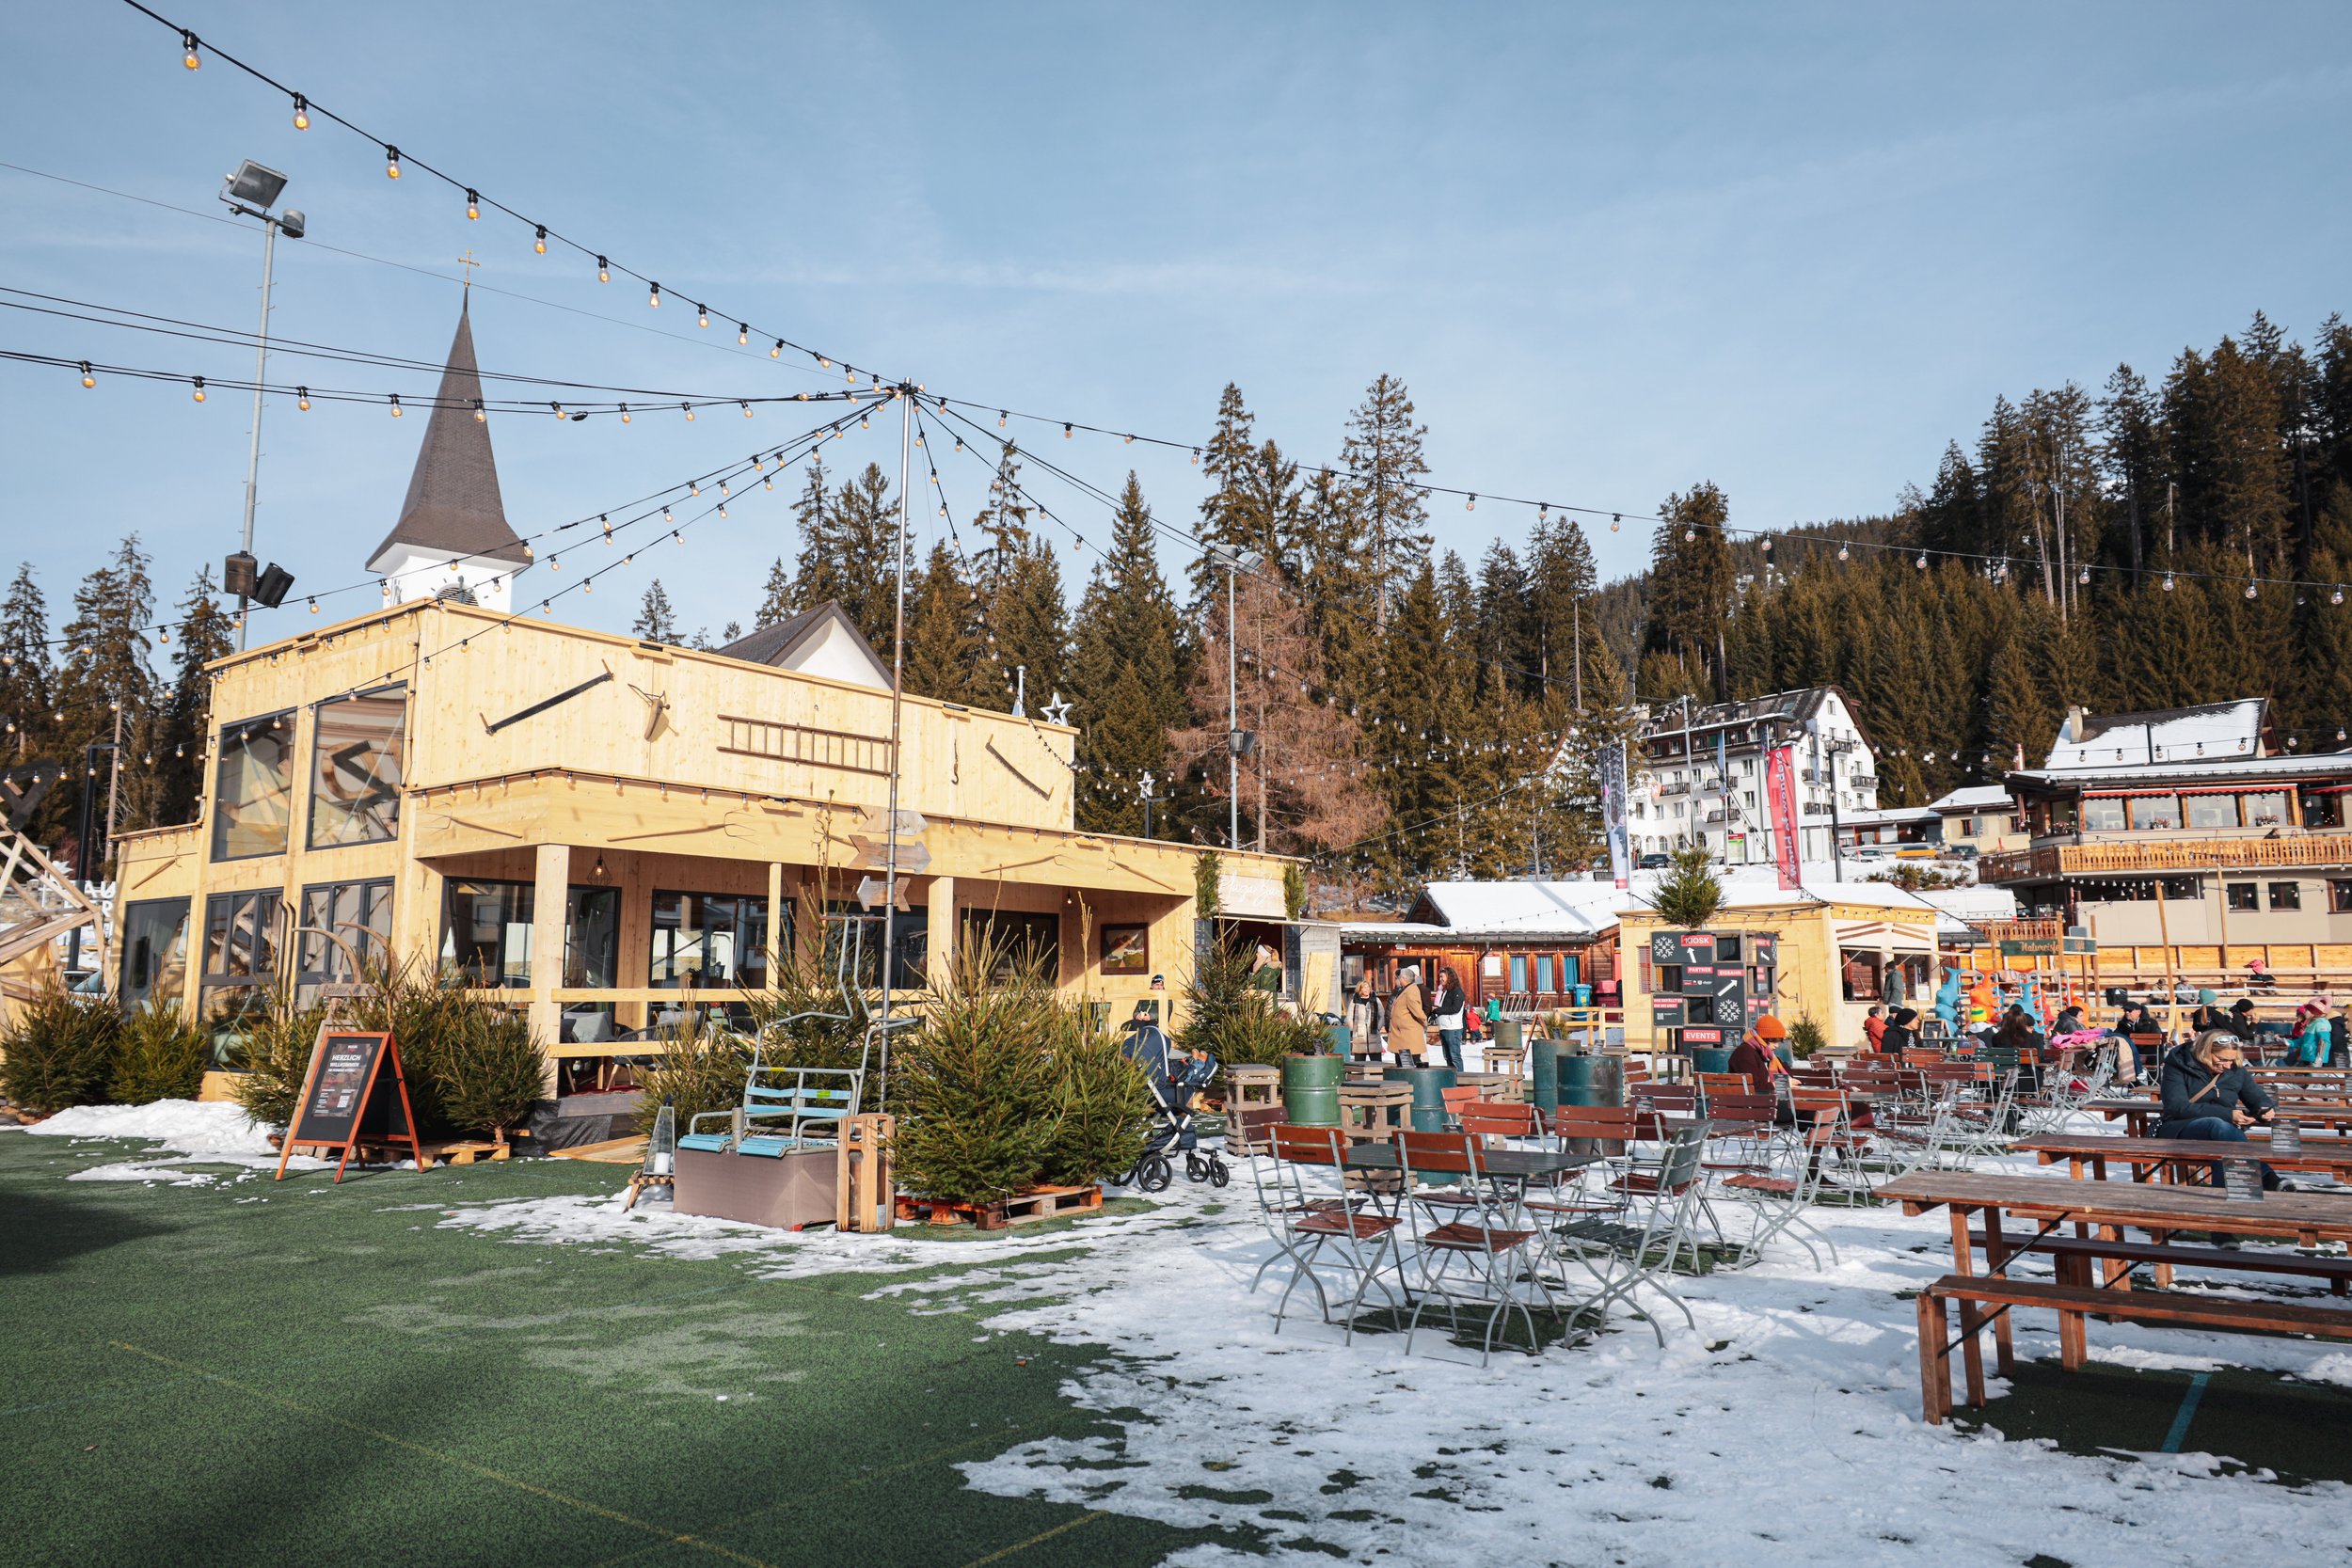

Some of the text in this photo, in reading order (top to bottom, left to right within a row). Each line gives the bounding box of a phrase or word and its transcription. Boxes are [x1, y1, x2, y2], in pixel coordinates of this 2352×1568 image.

[1775, 751, 1788, 814] wonders
[1781, 816, 1790, 832] of
[1784, 835, 1796, 877] world
